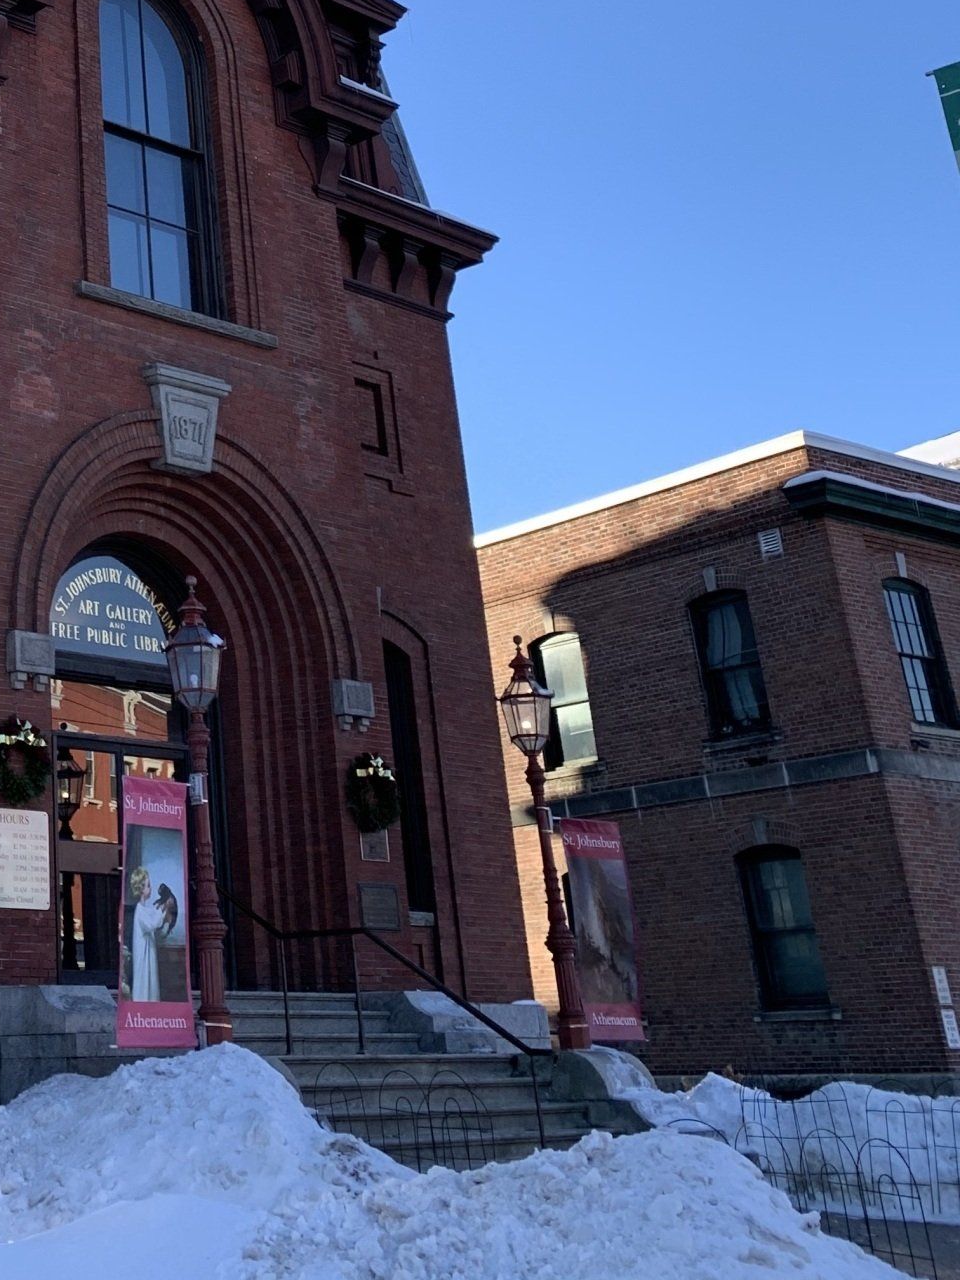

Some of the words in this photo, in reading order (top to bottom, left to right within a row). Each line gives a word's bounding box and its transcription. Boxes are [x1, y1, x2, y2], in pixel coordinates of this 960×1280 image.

[171, 415, 204, 446] 1871
[55, 595, 71, 616] ST.
[65, 567, 123, 600] JOHNSBURY
[78, 599, 100, 617] ART
[106, 603, 154, 626] GALLERY
[51, 621, 81, 641] FREE
[87, 626, 128, 648] PUBLIC
[109, 621, 126, 630] AND
[0, 813, 30, 825] HOURS
[137, 796, 184, 820] Johnsbury
[576, 833, 621, 854] Johnsbury
[125, 1012, 187, 1029] Athenaeum
[592, 1012, 638, 1026] Athenaeum
